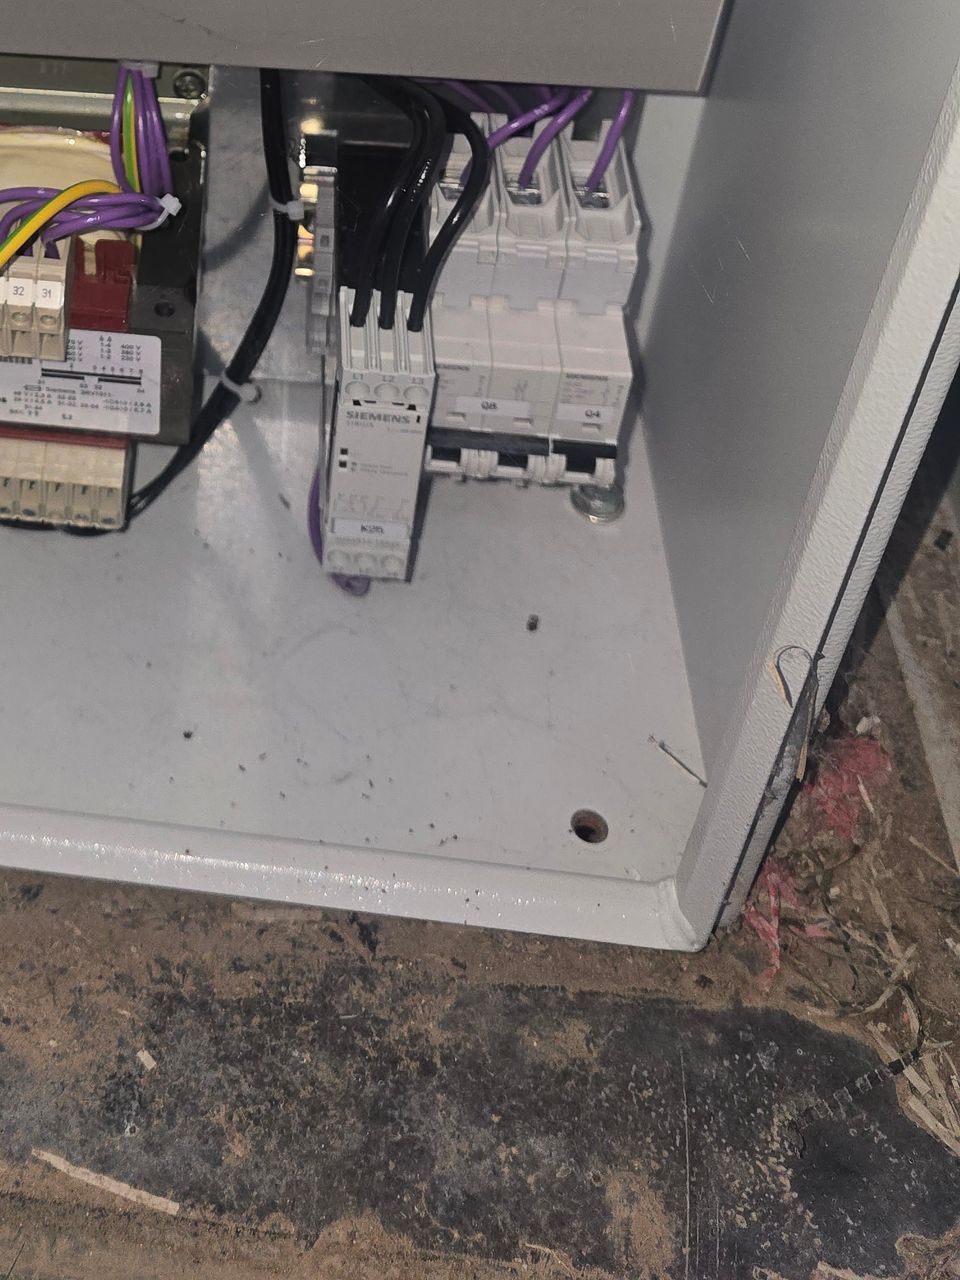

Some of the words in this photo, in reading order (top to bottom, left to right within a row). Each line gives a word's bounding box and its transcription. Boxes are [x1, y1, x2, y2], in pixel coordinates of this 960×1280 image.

[13, 286, 24, 296] 32
[42, 288, 52, 298] 31
[346, 411, 410, 424] SIEMENS
